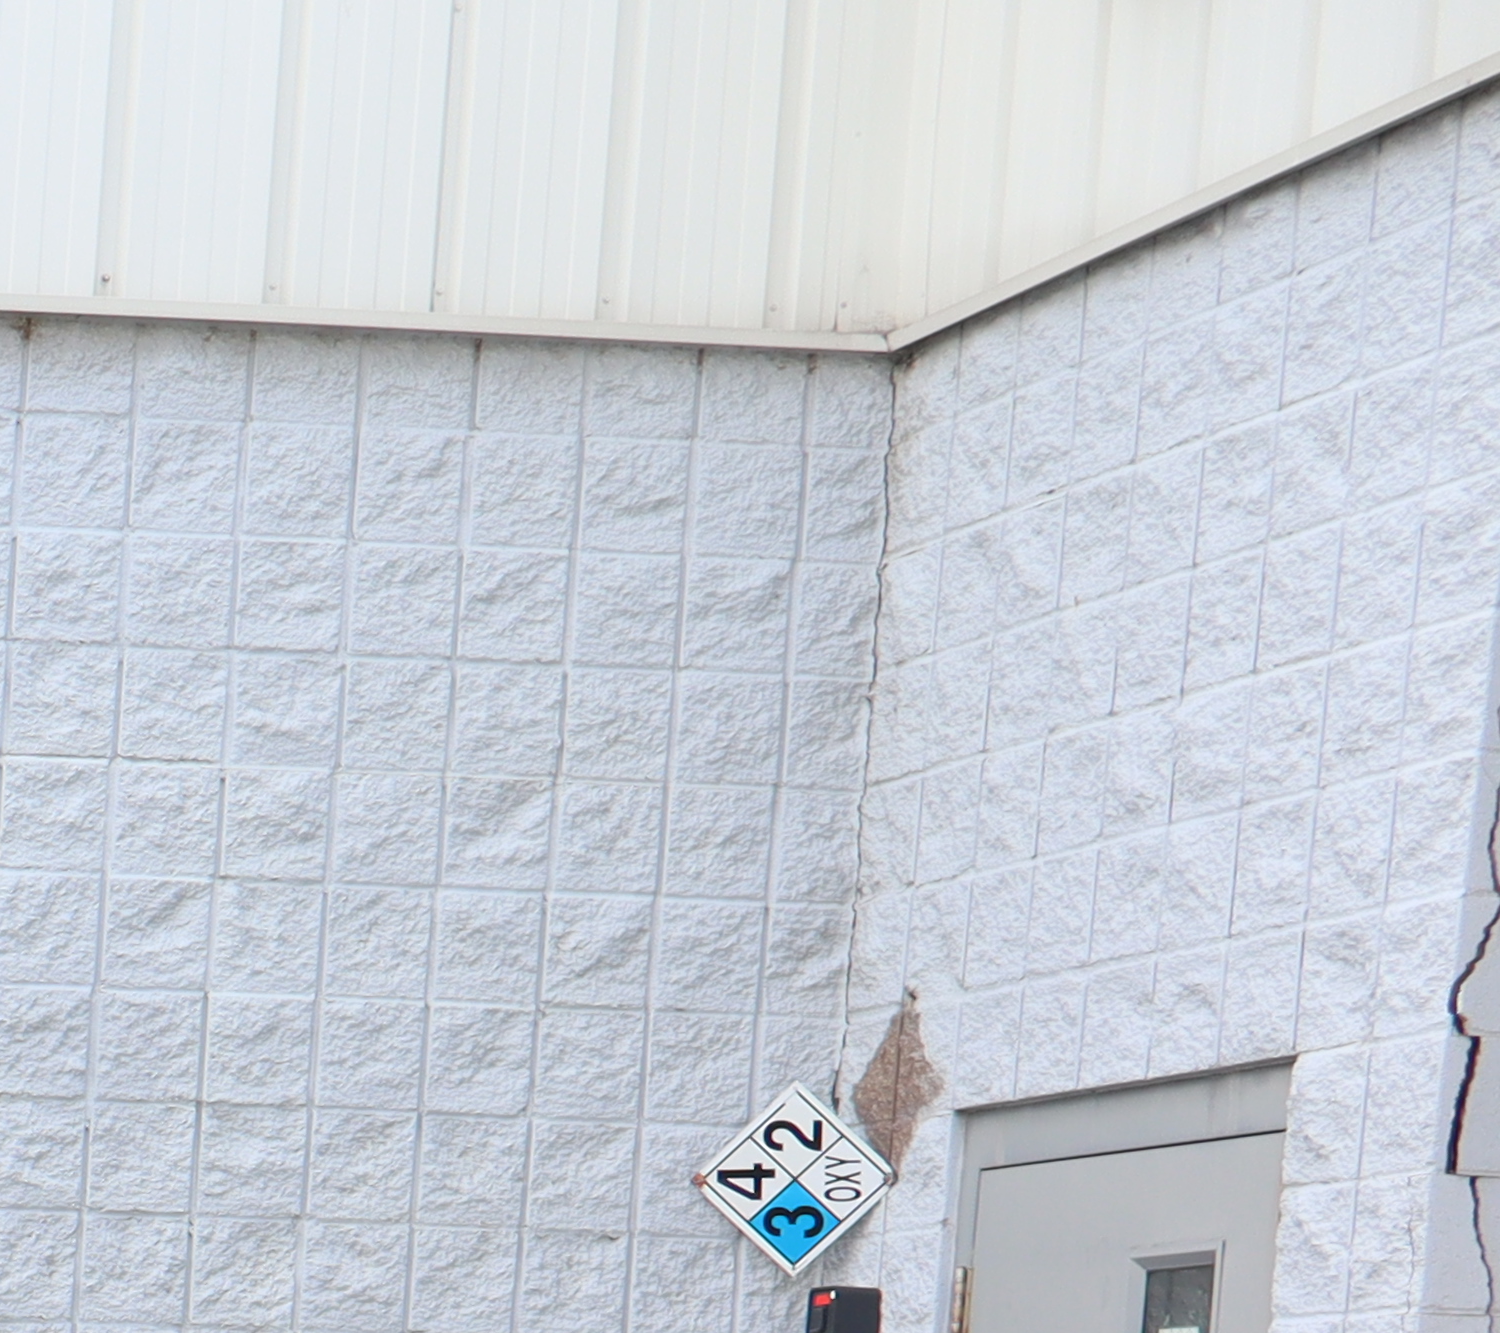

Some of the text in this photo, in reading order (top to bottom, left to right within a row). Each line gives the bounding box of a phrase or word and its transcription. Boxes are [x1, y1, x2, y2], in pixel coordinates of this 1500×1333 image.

[763, 1120, 822, 1151] 2
[717, 1163, 775, 1200] 4
[824, 1155, 862, 1202] OXY
[763, 1205, 824, 1238] 3
